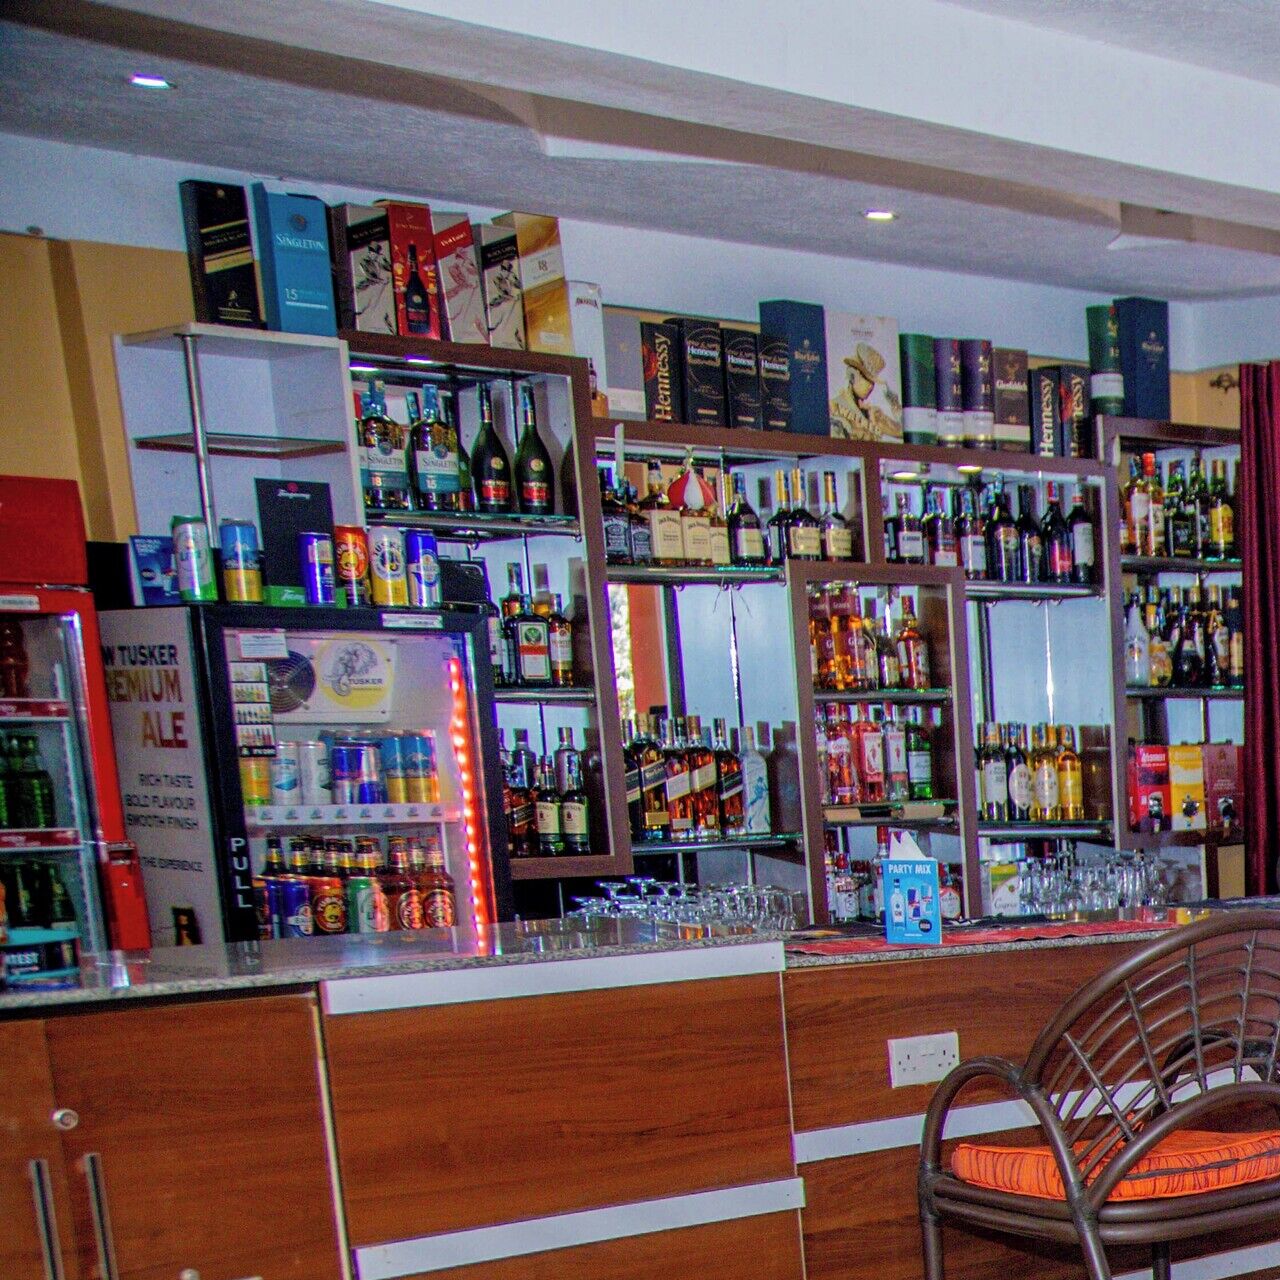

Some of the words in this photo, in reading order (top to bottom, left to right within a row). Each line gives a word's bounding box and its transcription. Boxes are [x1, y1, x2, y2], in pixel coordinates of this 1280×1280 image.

[275, 233, 326, 250] SINGLETON
[284, 288, 299, 301] 15
[687, 345, 720, 359] Hennessy
[727, 354, 755, 368] Hennessy
[655, 332, 672, 421] Hennessy
[1039, 374, 1054, 457] Hennessy
[372, 475, 382, 487] 18
[117, 644, 179, 666] TUSKER
[348, 677, 383, 686] TUSKER
[142, 711, 189, 749] ALE
[138, 772, 162, 788] RICH
[163, 774, 194, 789] TASTE
[151, 795, 195, 811] FLAVOUR
[127, 814, 165, 829] SMOOTH
[166, 816, 199, 831] FINISH
[159, 857, 204, 873] EXPERIENCE
[230, 837, 253, 909] PULL
[888, 863, 913, 874] PARTY
[915, 863, 932, 875] MIX
